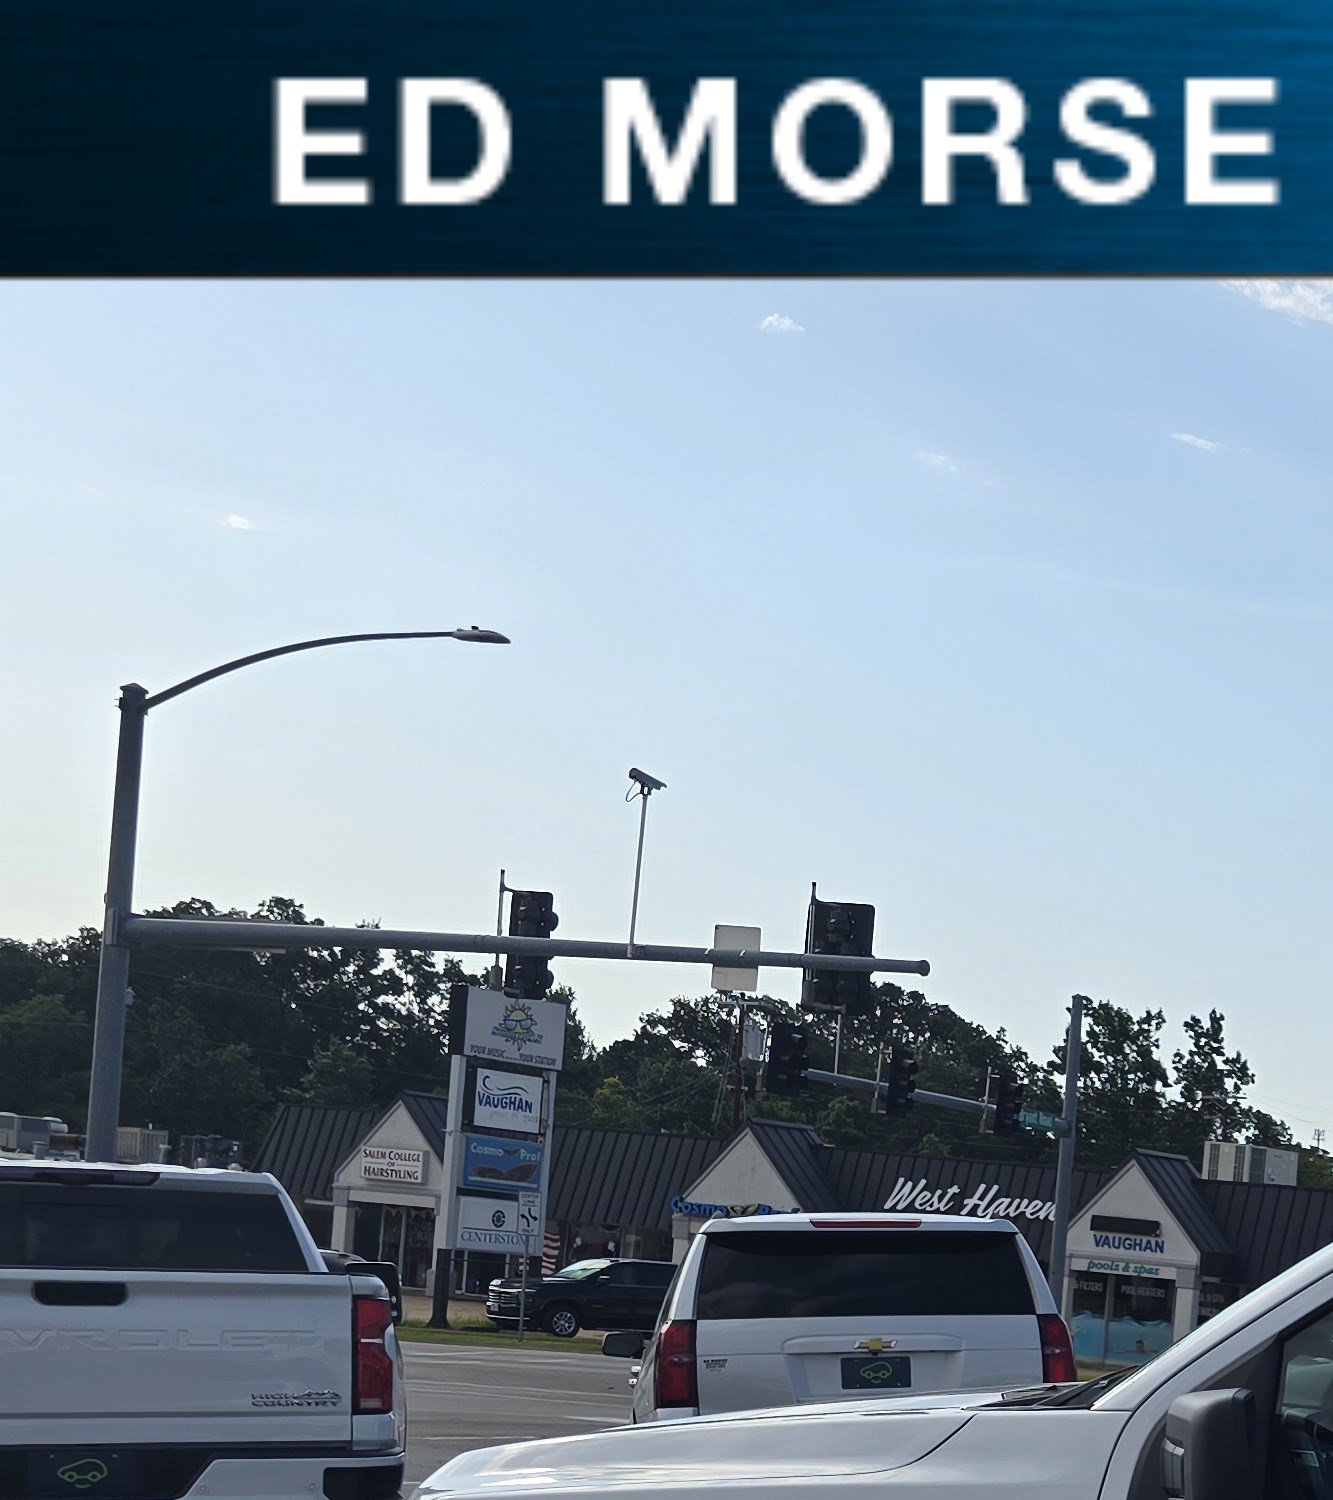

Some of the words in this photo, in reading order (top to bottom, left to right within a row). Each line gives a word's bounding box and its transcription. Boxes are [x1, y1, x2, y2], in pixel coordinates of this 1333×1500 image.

[478, 1092, 533, 1113] VAUGHAN
[363, 1149, 386, 1159] SALEM
[388, 1151, 421, 1162] COLLEGE
[471, 1142, 504, 1156] Cosmo
[363, 1165, 419, 1180] HAIRSTYLING
[883, 1177, 961, 1212] West
[960, 1183, 1056, 1221] Haven
[461, 1231, 530, 1246] CENTERSTON
[1093, 1234, 1165, 1254] VAUGHAN
[1087, 1260, 1119, 1272] pools
[1122, 1262, 1130, 1272] &
[1132, 1264, 1160, 1277] spas
